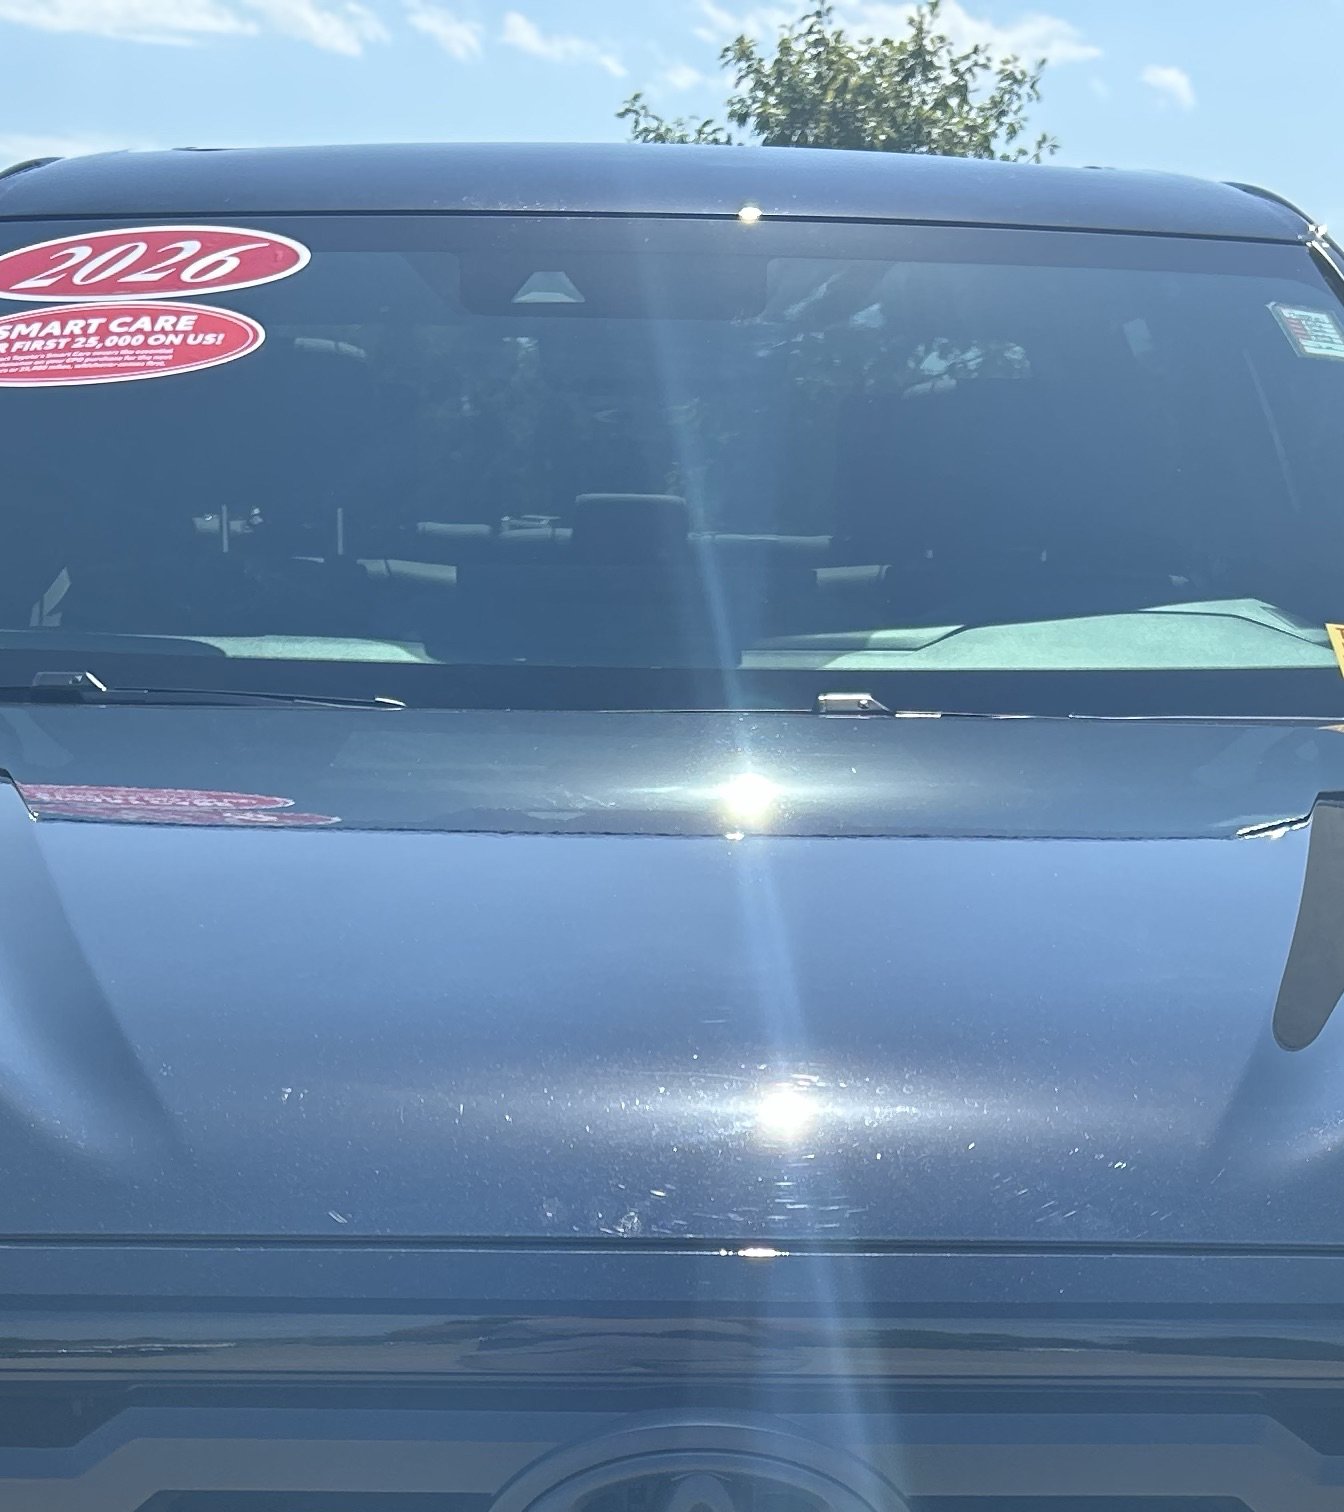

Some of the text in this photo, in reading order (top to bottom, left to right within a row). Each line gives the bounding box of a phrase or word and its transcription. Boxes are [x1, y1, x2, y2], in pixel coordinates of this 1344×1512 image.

[9, 240, 271, 291] 2026
[108, 314, 199, 333] CARE
[10, 337, 71, 354] FIRST
[71, 334, 146, 350] 25,000
[146, 333, 186, 347] ON
[186, 332, 226, 346] US!
